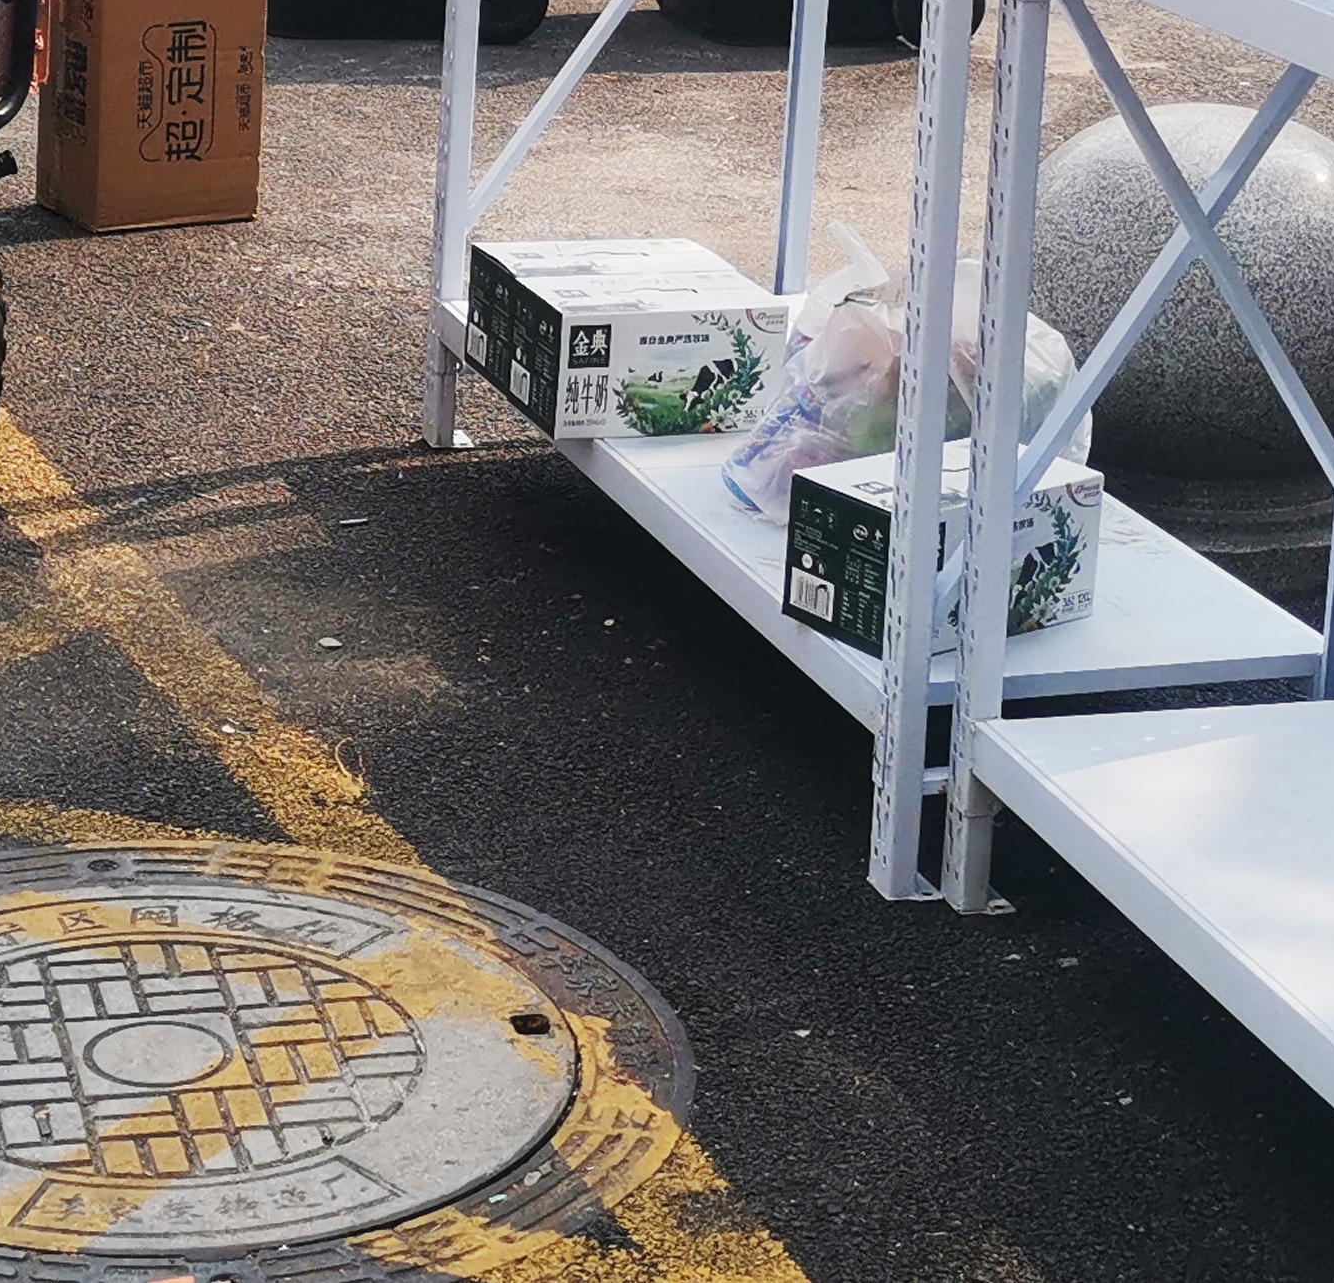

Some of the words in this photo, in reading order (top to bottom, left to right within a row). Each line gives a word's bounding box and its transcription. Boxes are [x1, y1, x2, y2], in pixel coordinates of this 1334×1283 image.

[137, 60, 154, 129] 天猫超市
[572, 329, 608, 356] 金典
[565, 374, 609, 414] 纯牛奶
